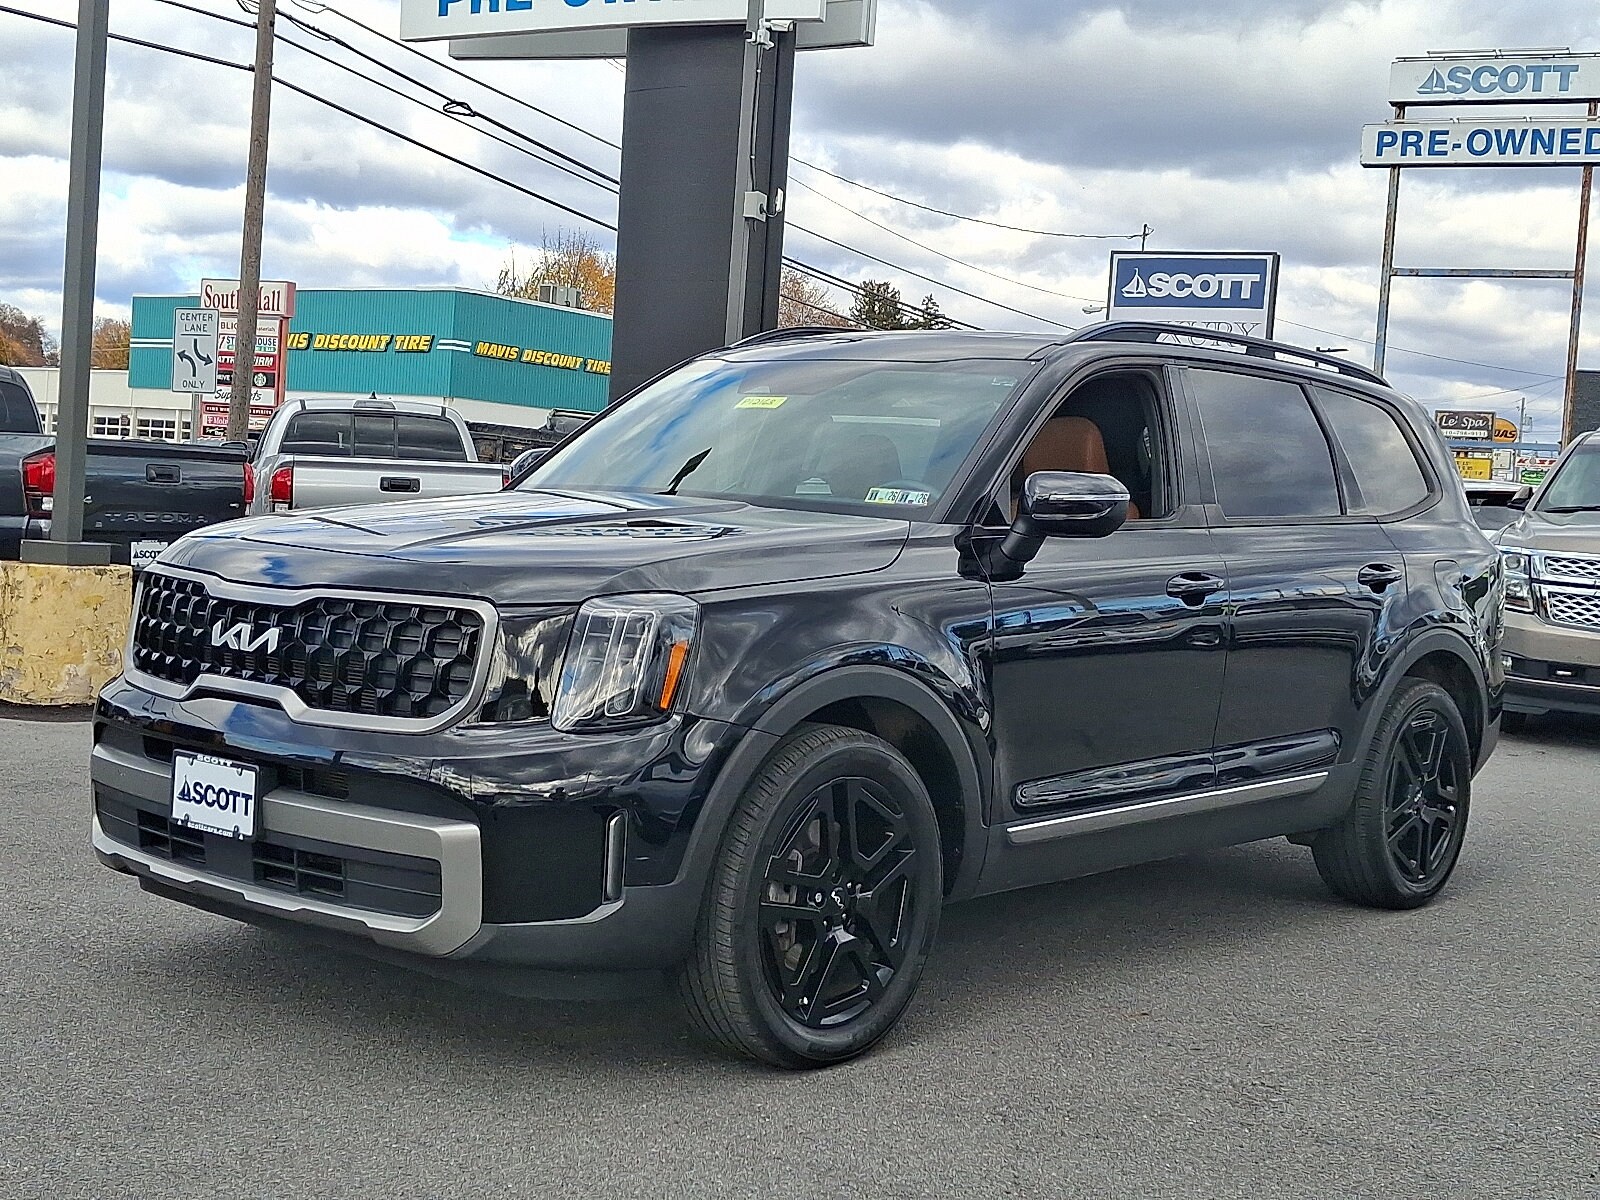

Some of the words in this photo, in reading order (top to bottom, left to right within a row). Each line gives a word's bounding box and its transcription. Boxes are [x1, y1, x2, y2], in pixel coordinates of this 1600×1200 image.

[1446, 64, 1580, 95] SCOTT
[1375, 127, 1600, 157] PRE-OWNED
[1148, 272, 1261, 299] SCOTT
[257, 286, 281, 311] all
[180, 312, 213, 322] CENTER
[184, 323, 208, 332] LANE
[288, 333, 311, 349] VIS
[313, 334, 391, 351] DISCOUNT
[395, 335, 433, 351] TIRE
[475, 341, 519, 361] MAVIS
[521, 349, 584, 370] DISCOUNT
[585, 358, 612, 374] TIRE
[182, 379, 205, 389] ONLY
[1461, 416, 1487, 429] Spa
[104, 511, 208, 523] TACOMA
[211, 618, 279, 654] KIA
[197, 754, 233, 767] SCOTT
[191, 781, 253, 817] SCOTT
